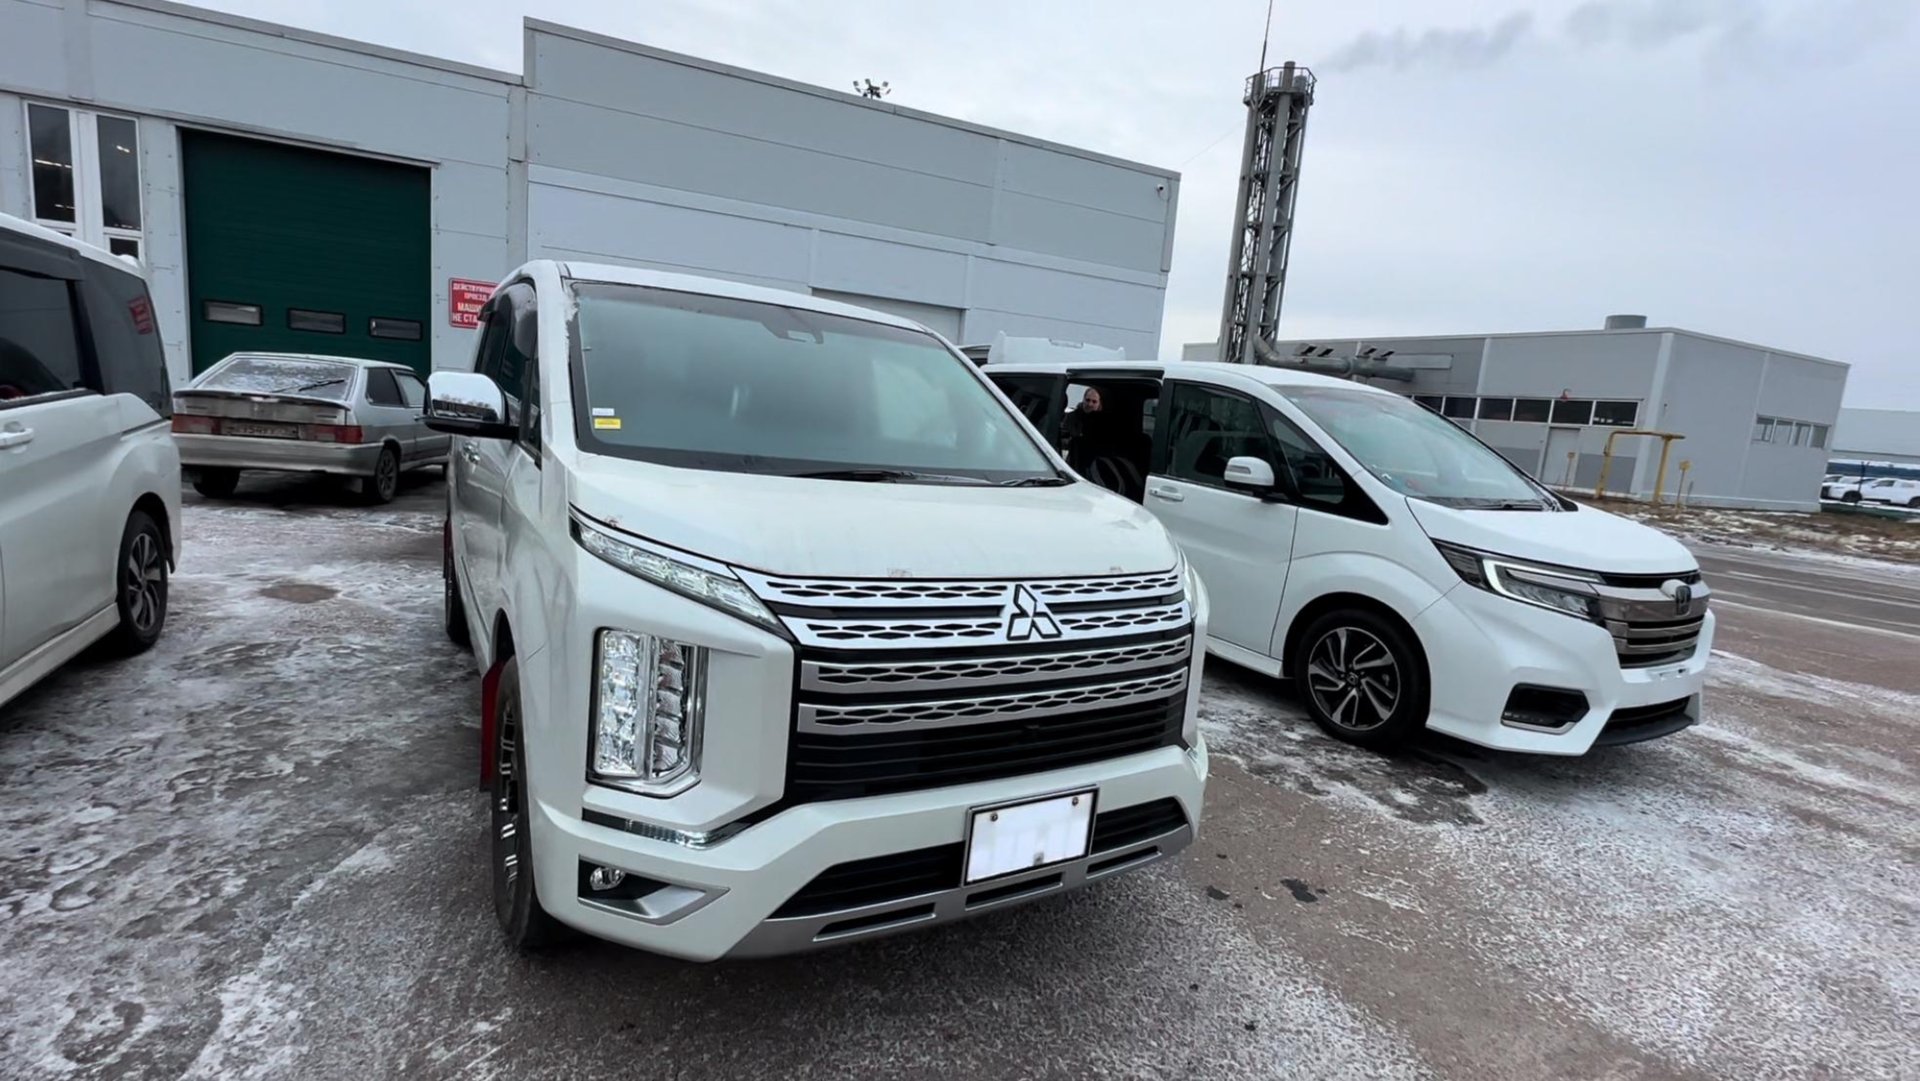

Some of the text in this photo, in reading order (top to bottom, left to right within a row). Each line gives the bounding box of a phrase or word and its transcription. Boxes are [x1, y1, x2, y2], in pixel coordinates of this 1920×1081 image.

[453, 283, 492, 294] ДЕЙСТВУЮЩ
[457, 303, 481, 312] МАШИ
[452, 312, 478, 323] НЕ СТА
